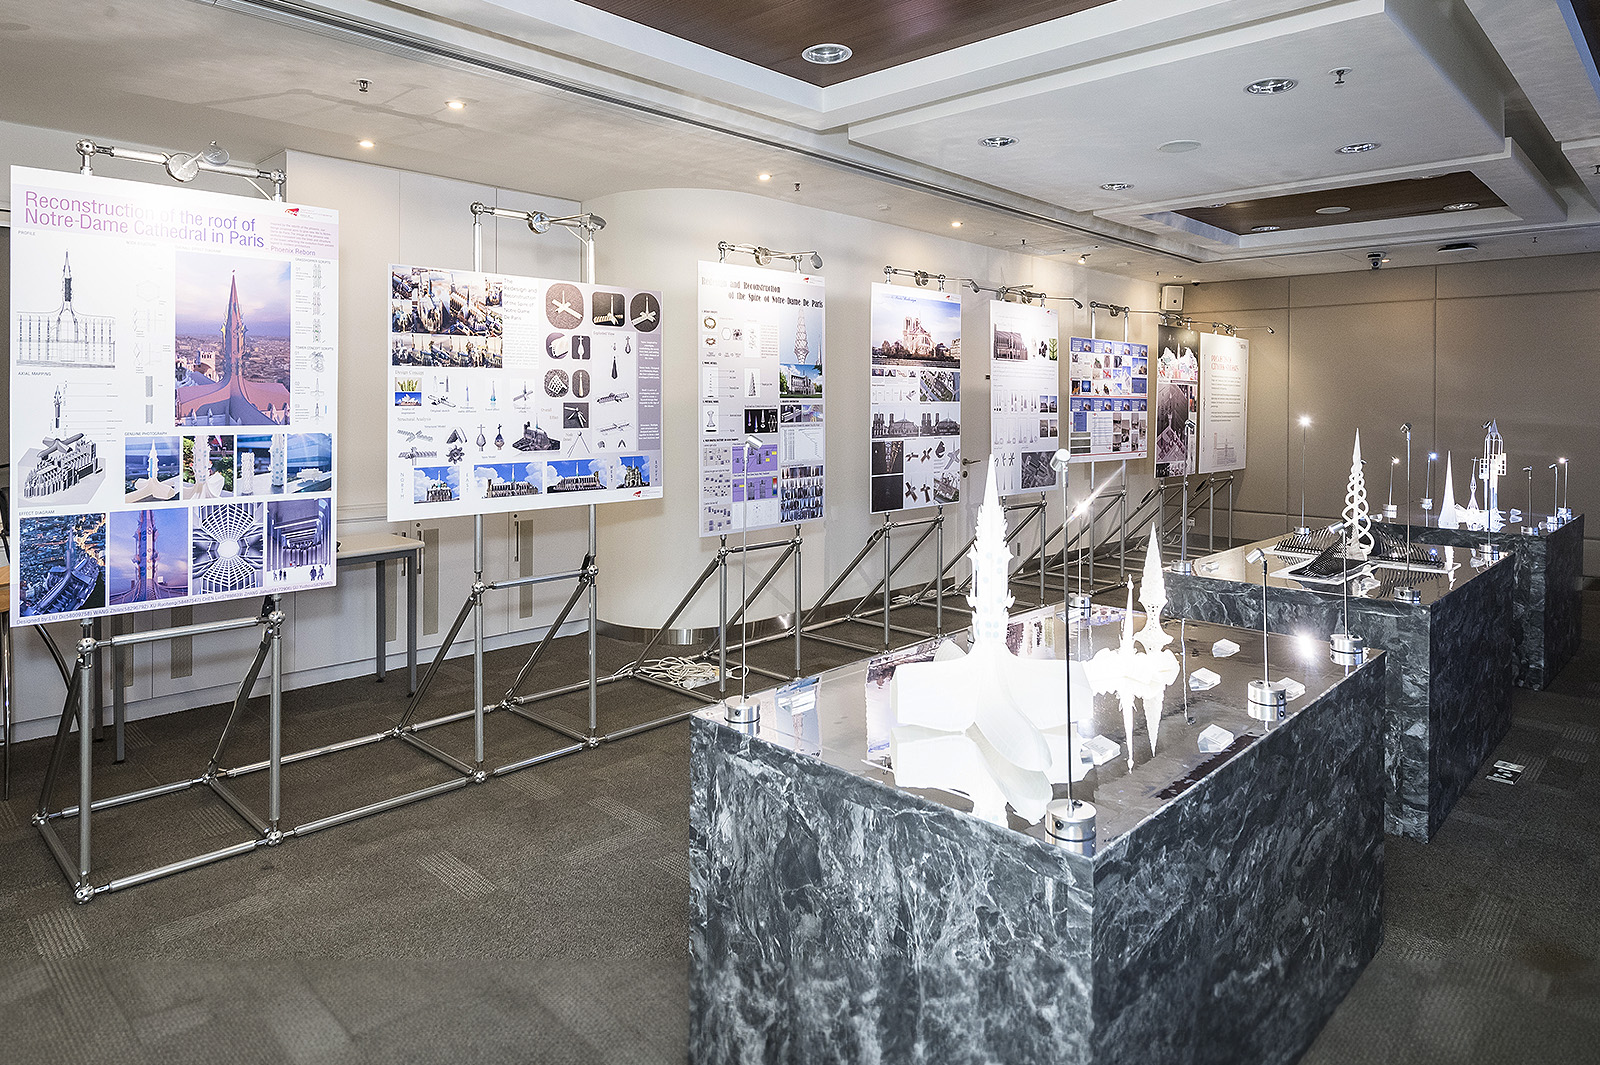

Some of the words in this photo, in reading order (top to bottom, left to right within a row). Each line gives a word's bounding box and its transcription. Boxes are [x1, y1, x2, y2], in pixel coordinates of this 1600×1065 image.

[25, 191, 154, 221] Reconstruction
[180, 210, 202, 226] the
[208, 216, 237, 230] roof
[242, 218, 256, 232] of
[26, 208, 128, 234] Notre-Dame
[134, 220, 206, 242] Cathedral
[212, 229, 224, 243] in
[230, 231, 264, 248] Paris
[744, 282, 780, 293] Reconstruction
[812, 300, 823, 308] Paris
